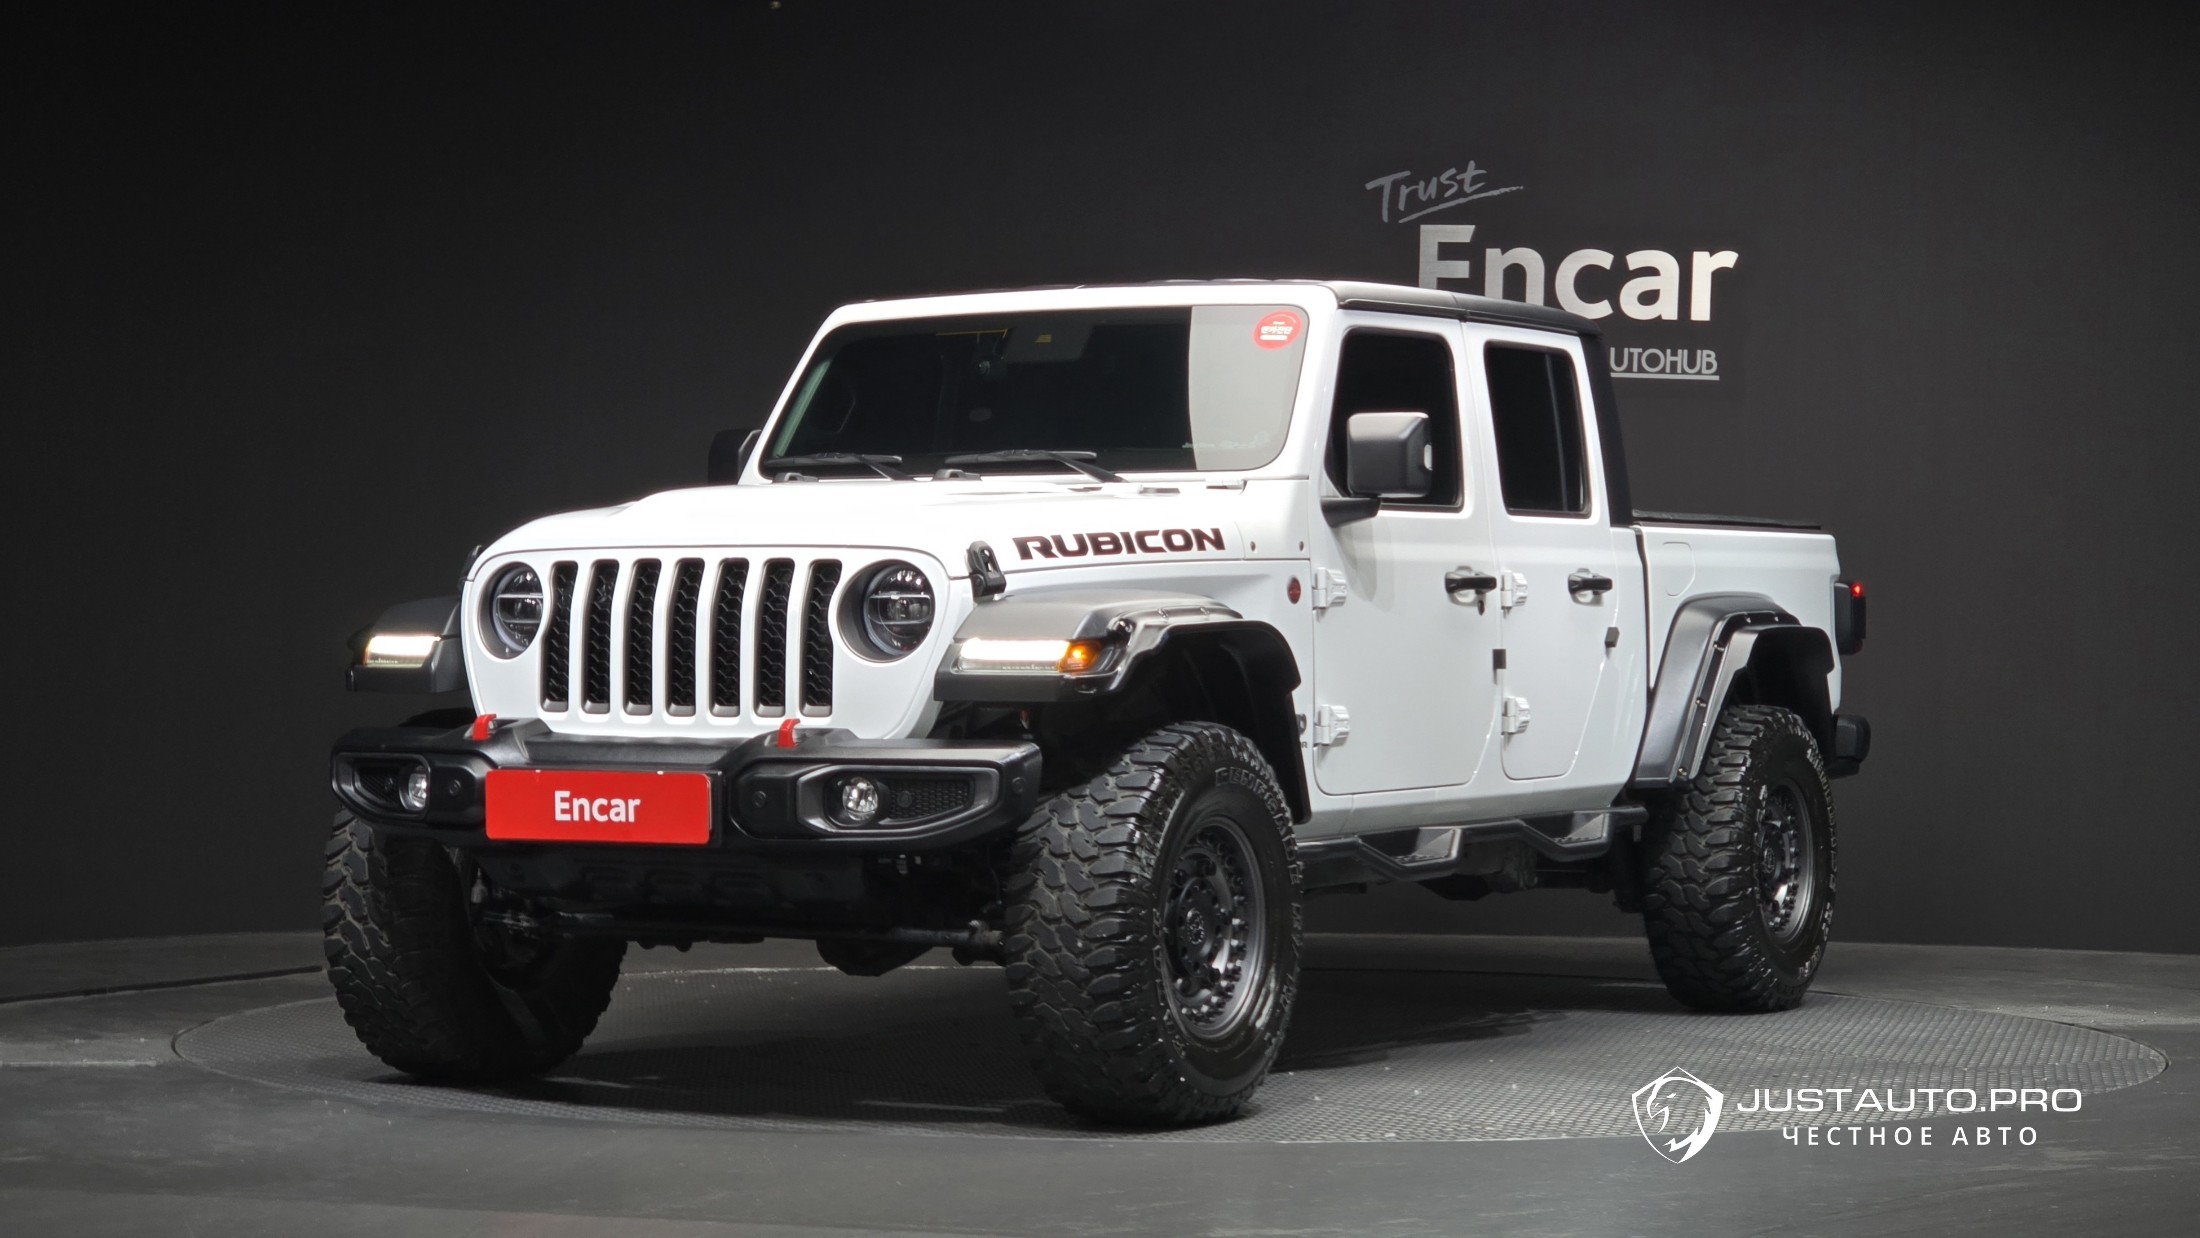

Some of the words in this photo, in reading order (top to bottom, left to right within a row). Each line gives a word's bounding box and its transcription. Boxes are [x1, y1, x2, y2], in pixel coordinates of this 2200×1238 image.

[1365, 159, 1488, 223] Trust
[1418, 224, 1740, 322] Encar
[1012, 527, 1226, 561] RUBICON
[554, 790, 641, 823] Encar
